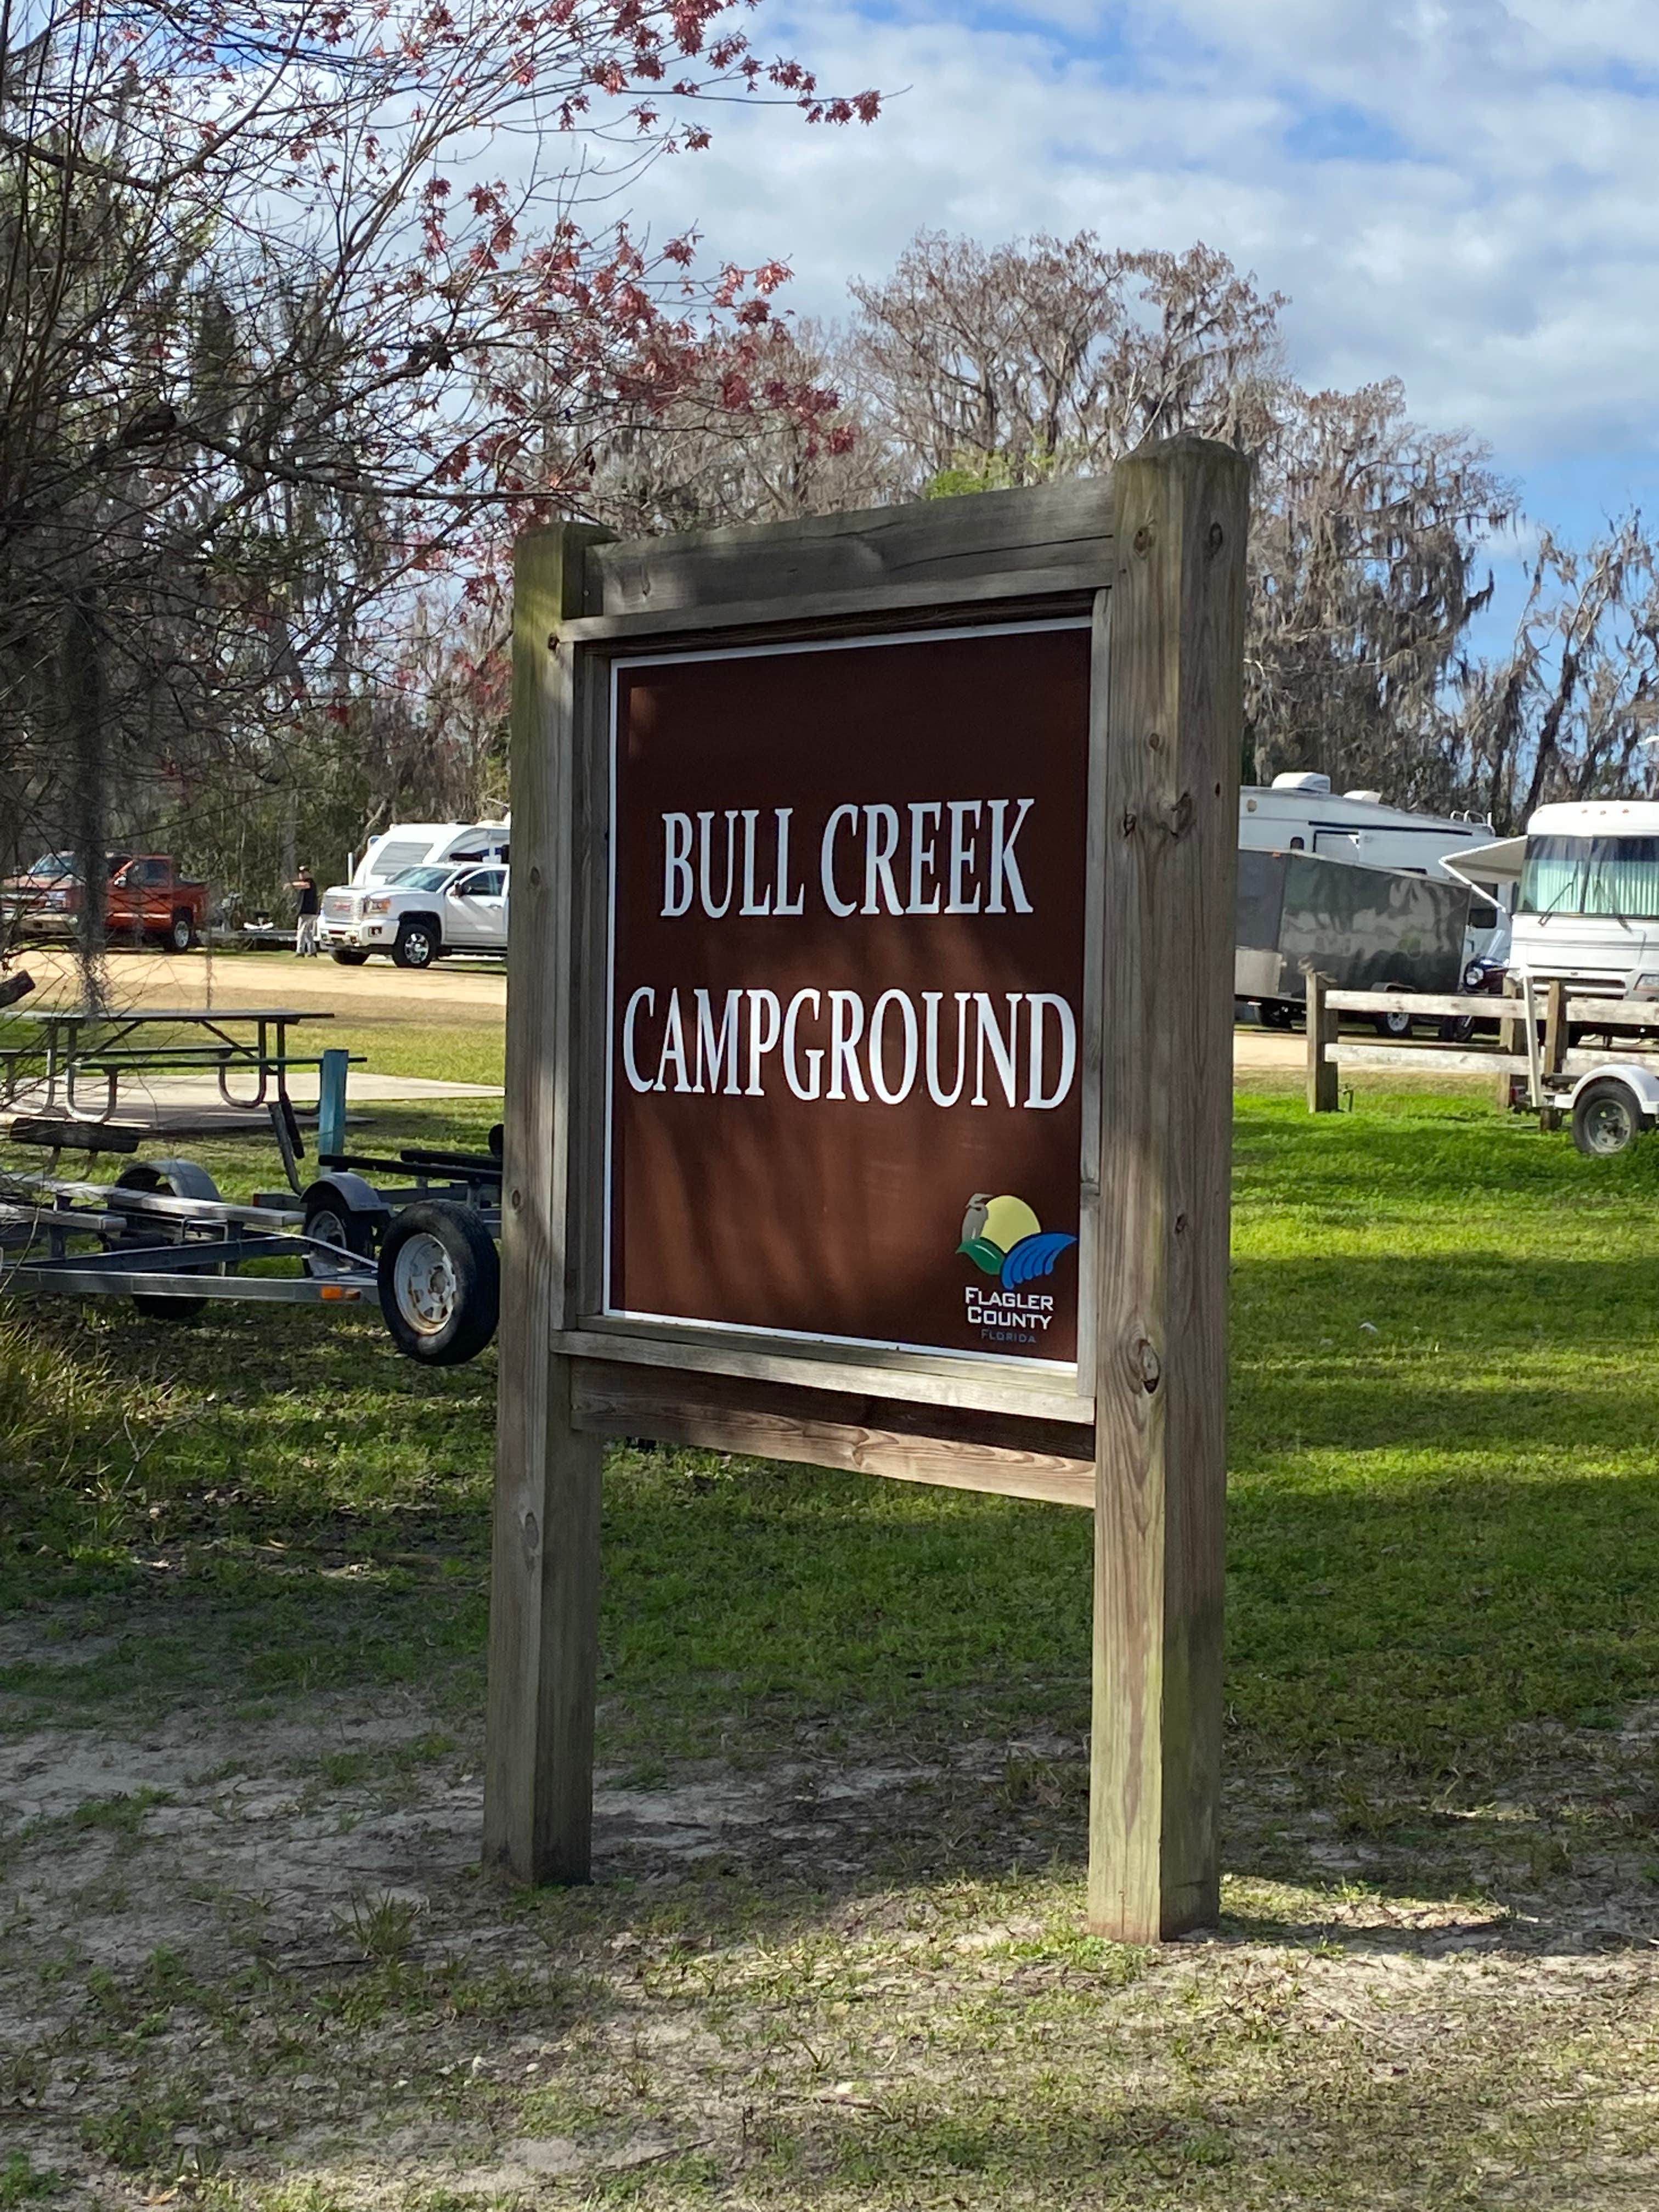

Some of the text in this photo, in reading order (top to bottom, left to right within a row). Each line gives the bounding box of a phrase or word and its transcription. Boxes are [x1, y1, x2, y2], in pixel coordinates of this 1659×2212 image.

[660, 798, 1035, 919] BULL CREEK
[623, 986, 1076, 1109] CAMPGROUND
[965, 1286, 1054, 1312] FLAGLER
[967, 1305, 1053, 1330] COUNTY
[981, 1328, 1036, 1344] FLORIDA
